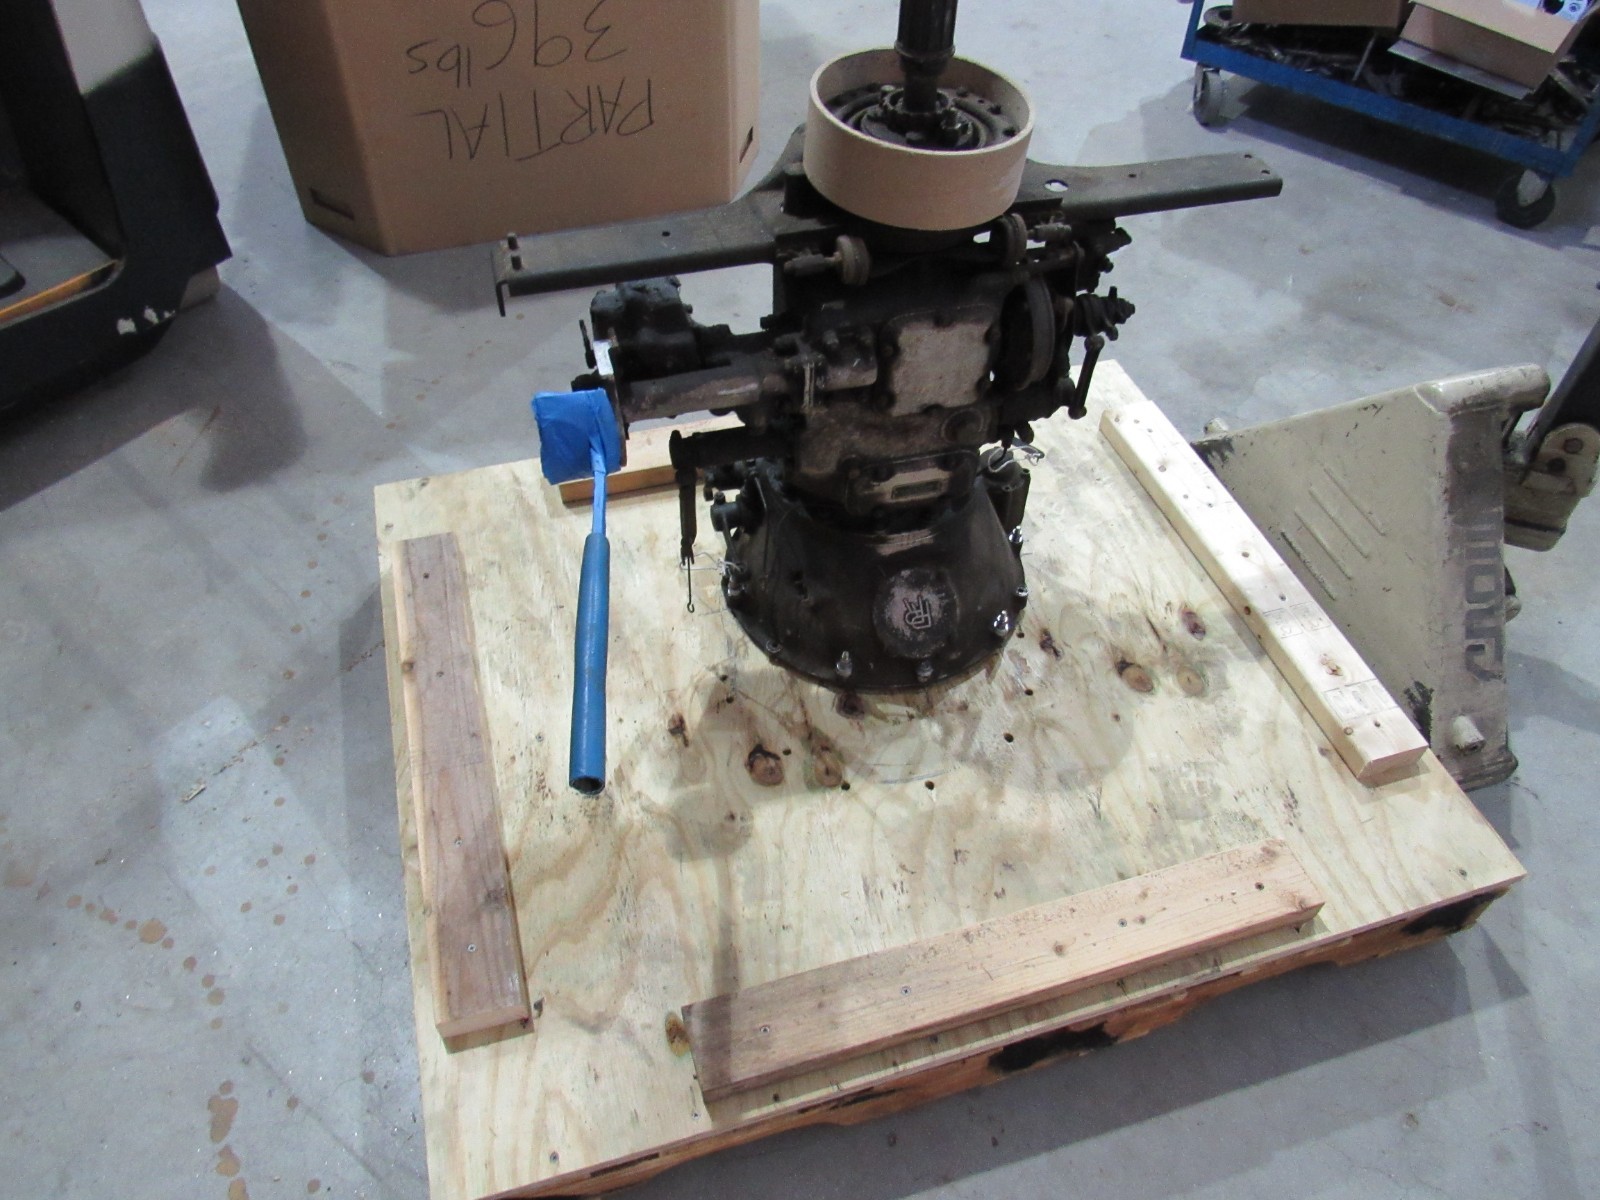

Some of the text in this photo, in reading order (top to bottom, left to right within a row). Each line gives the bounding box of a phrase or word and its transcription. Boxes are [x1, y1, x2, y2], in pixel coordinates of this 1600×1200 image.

[404, 0, 628, 88] 396 lbs
[412, 76, 655, 162] PARTIAL
